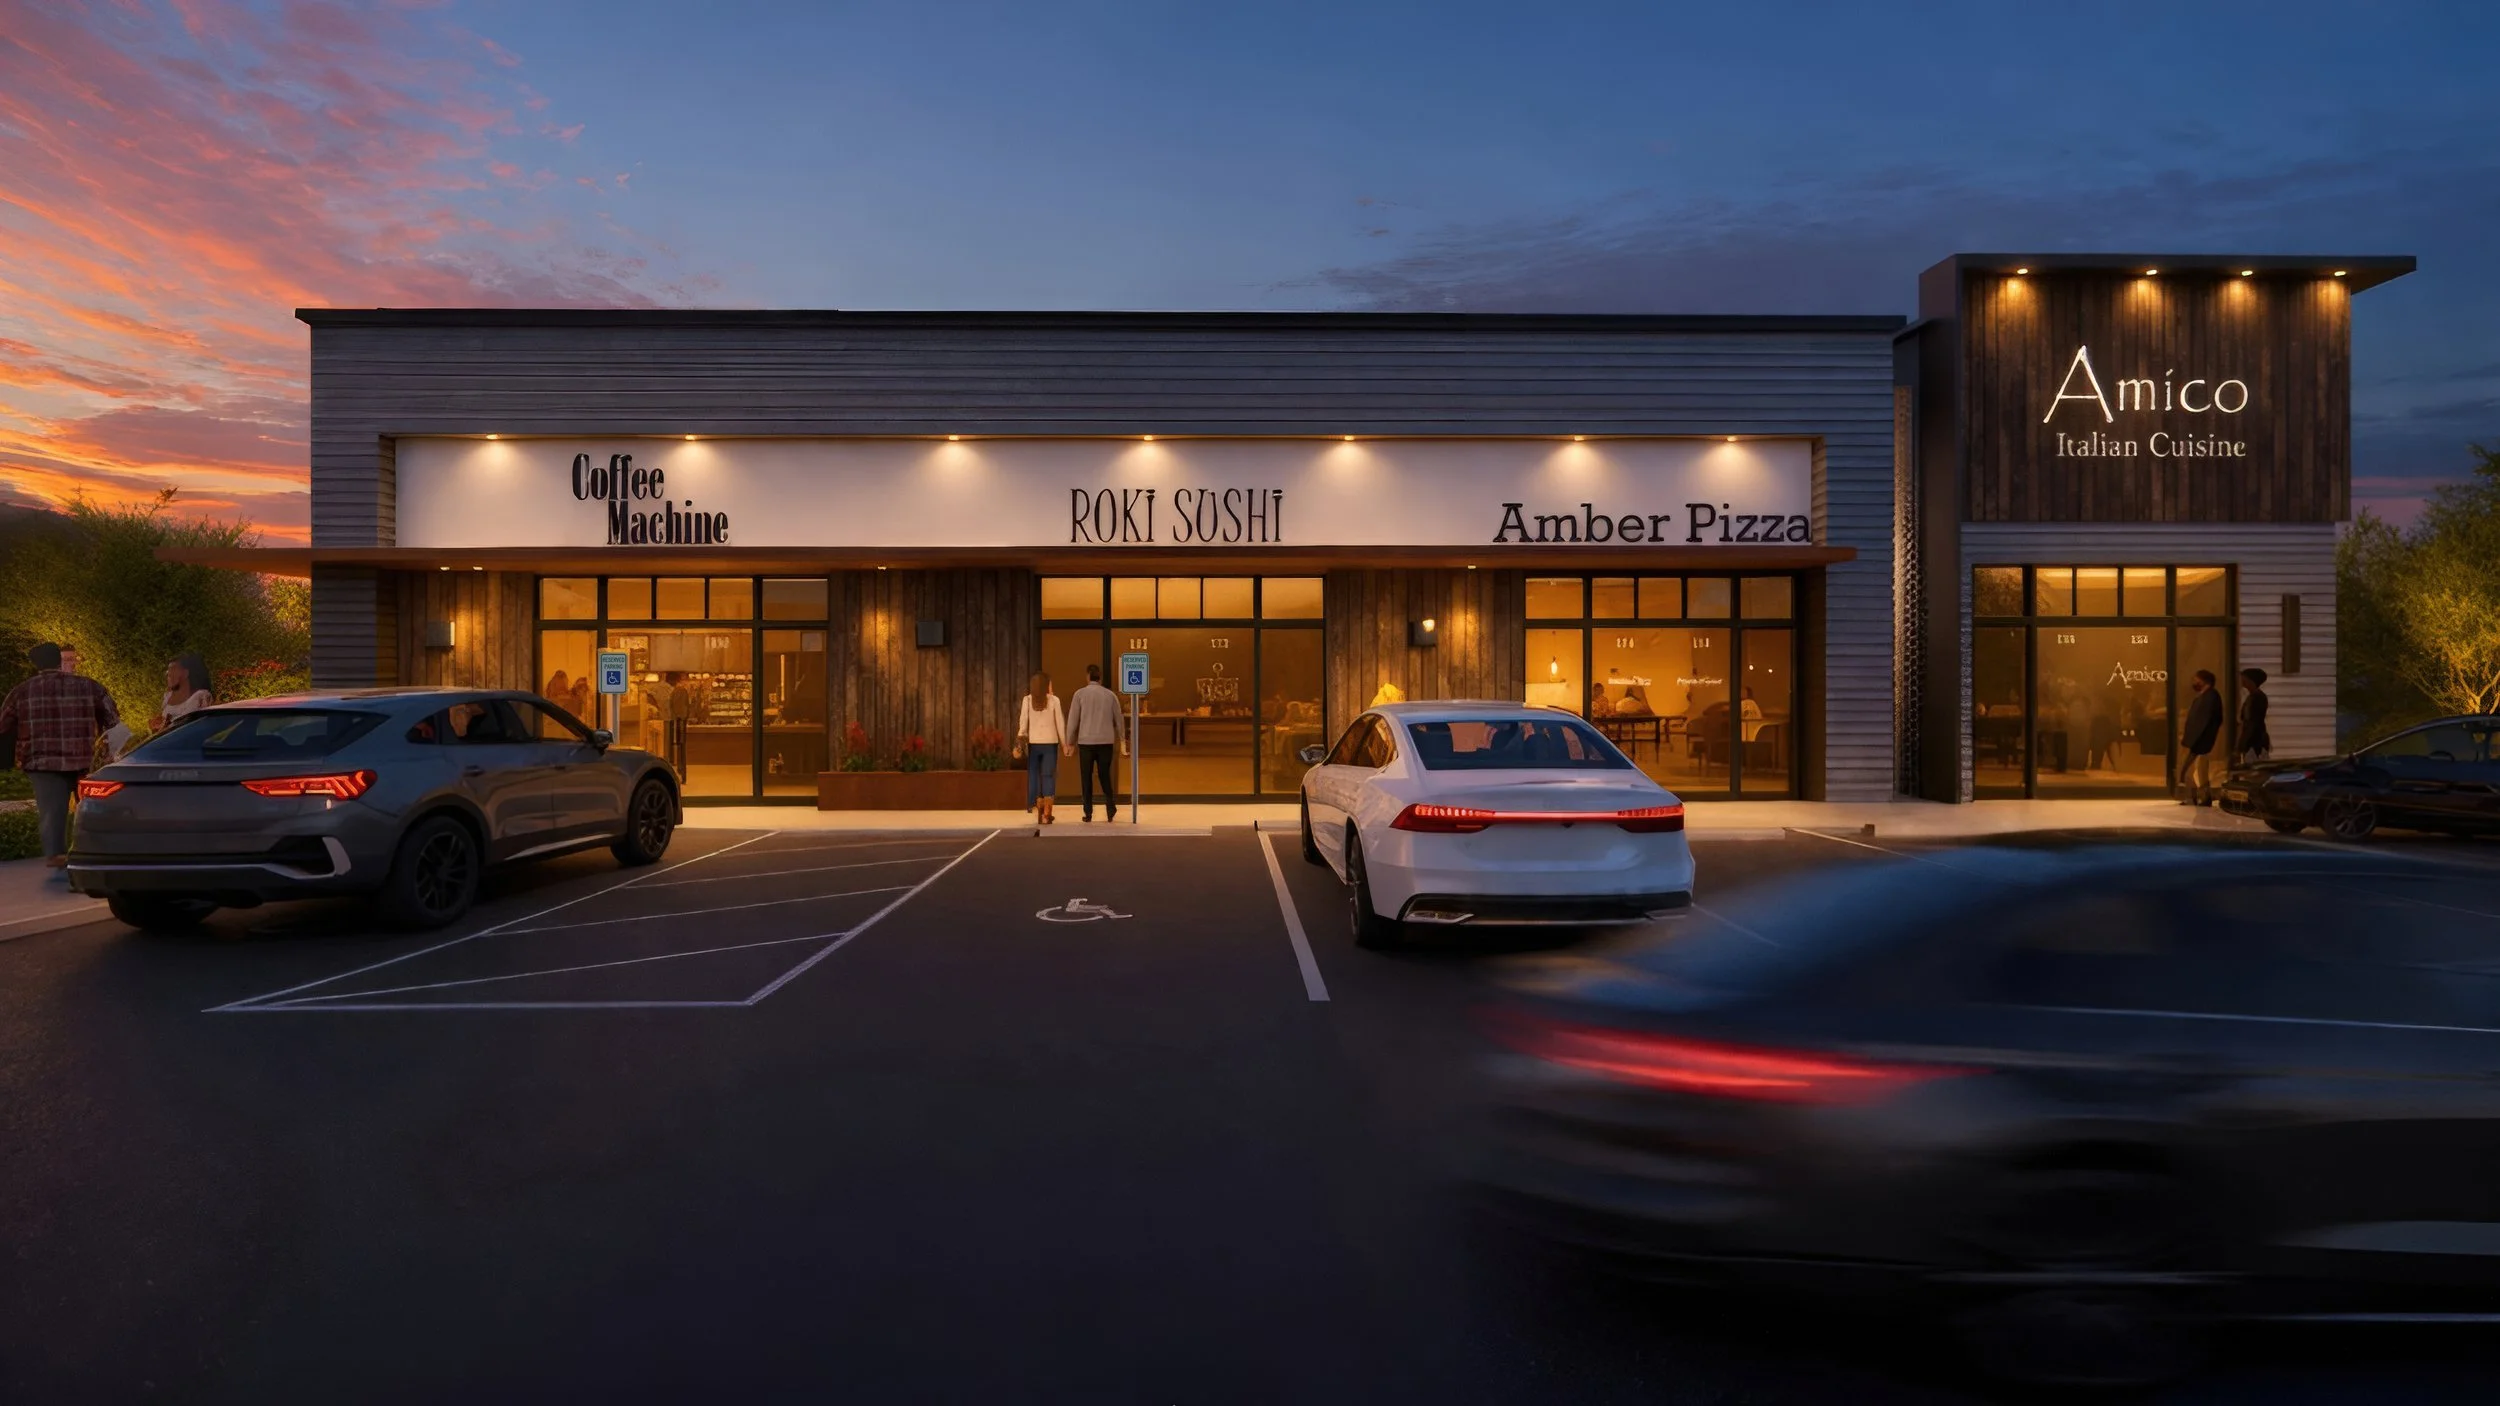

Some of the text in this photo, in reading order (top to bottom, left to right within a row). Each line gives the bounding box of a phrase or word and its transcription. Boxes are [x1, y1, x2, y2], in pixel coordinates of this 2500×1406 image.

[2043, 345, 2249, 424] Amico
[2055, 431, 2247, 459] Italian Cuisine
[572, 453, 665, 501] Coffee
[607, 499, 729, 545] Machine
[1492, 502, 1812, 544] Amber Pizza
